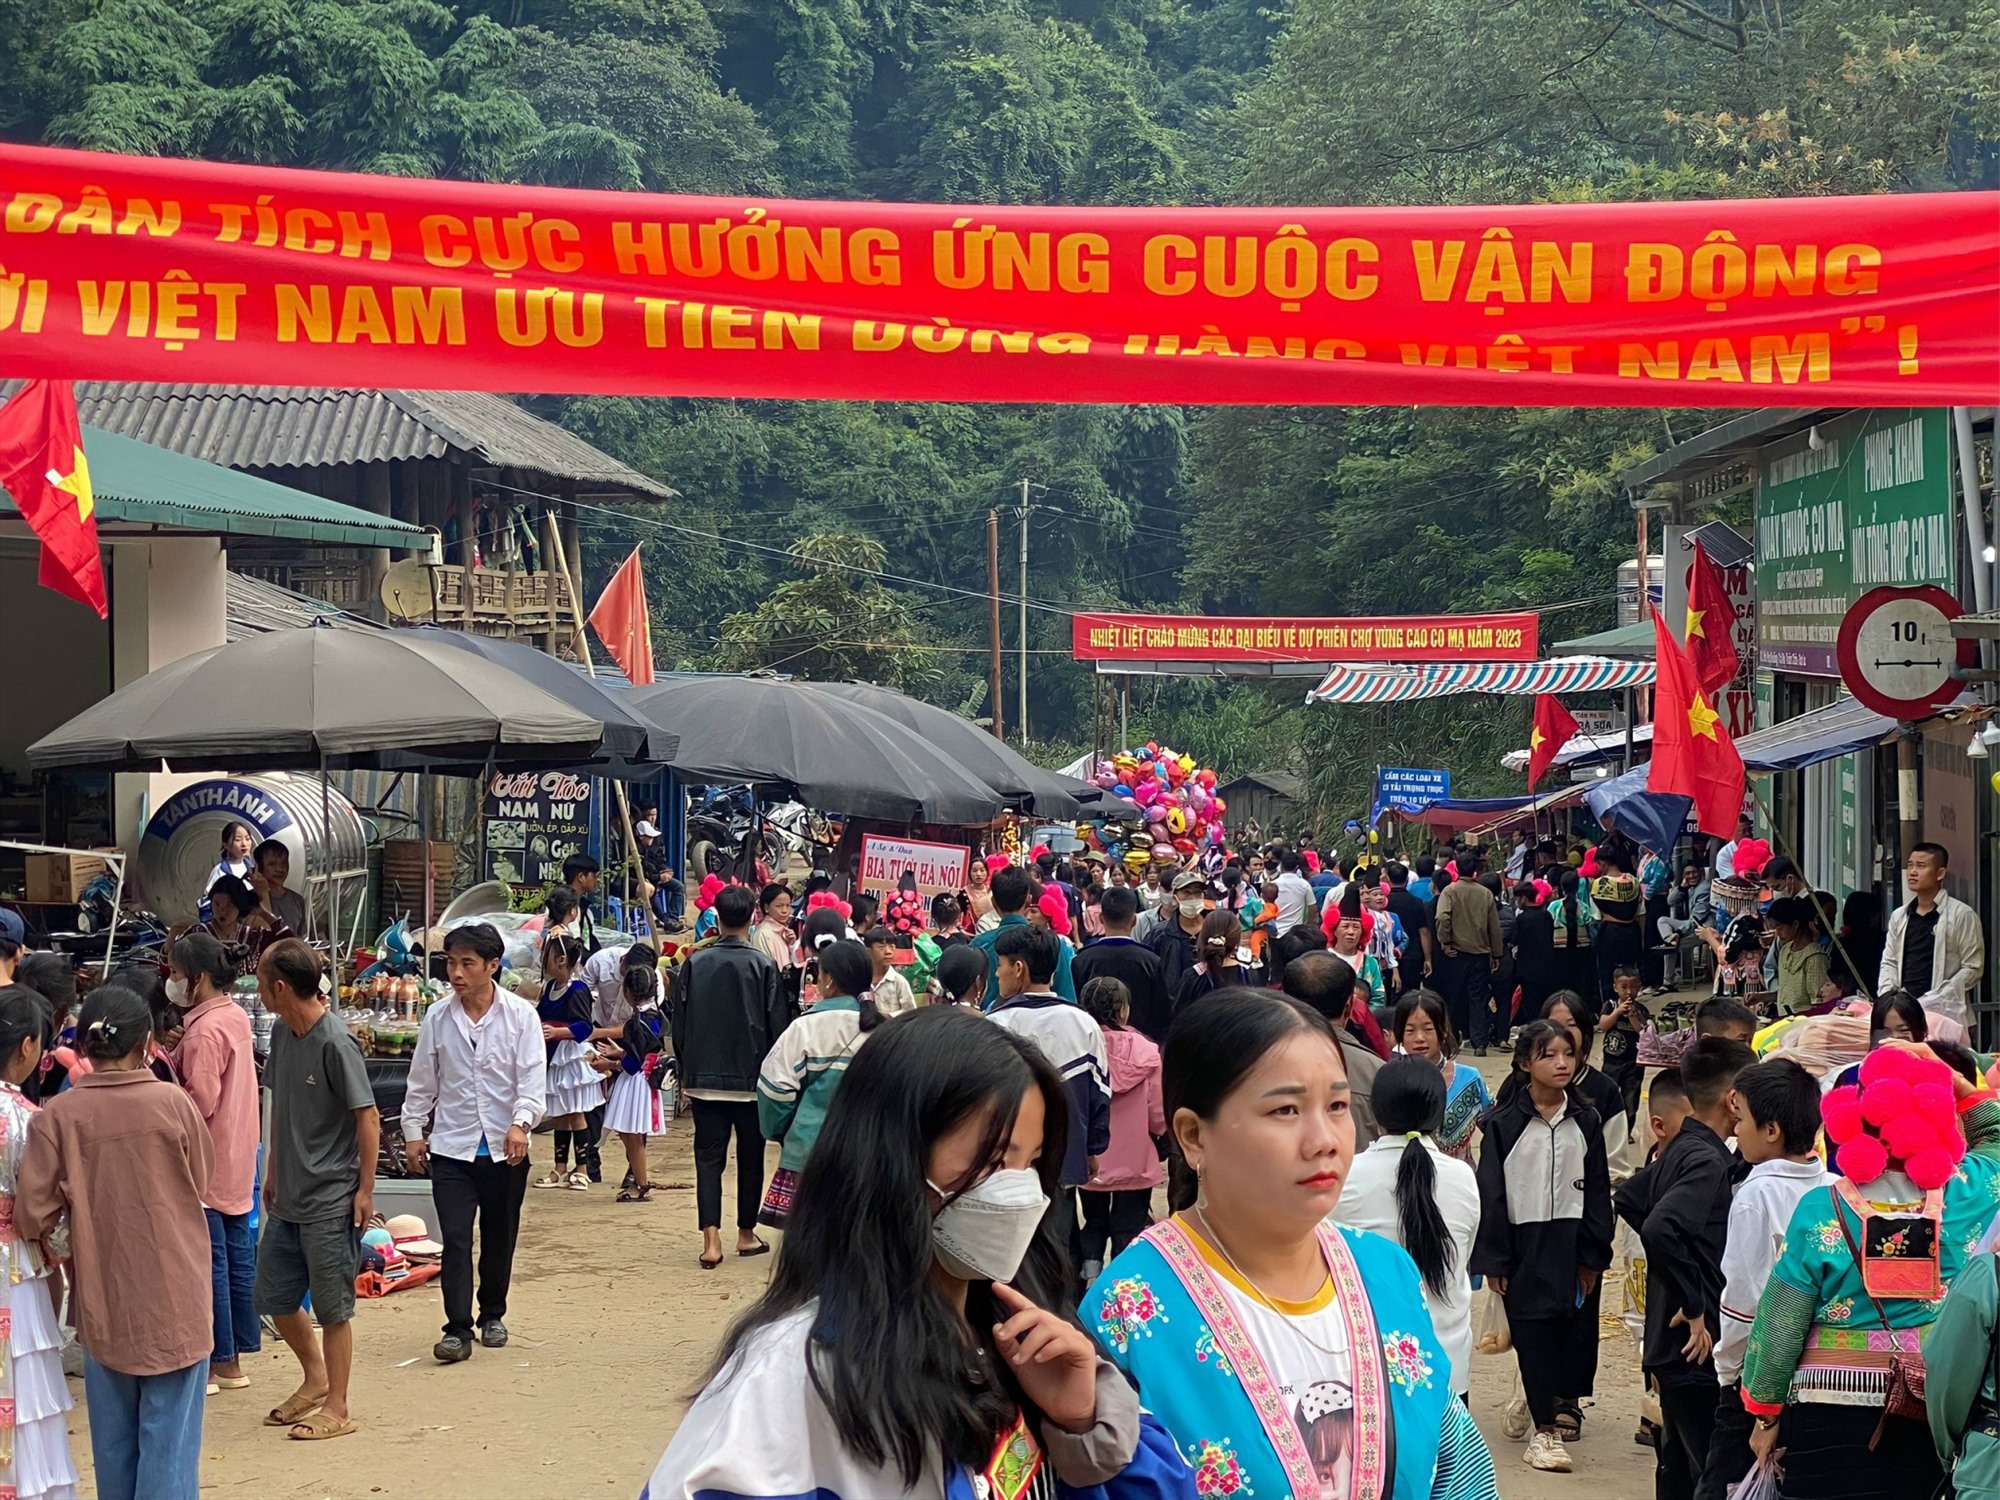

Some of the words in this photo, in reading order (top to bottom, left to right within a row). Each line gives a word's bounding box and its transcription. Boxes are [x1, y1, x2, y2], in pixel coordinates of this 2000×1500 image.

[5, 185, 182, 237] DÂN
[209, 195, 392, 261] TÍCH
[420, 212, 583, 279] CỰC
[612, 207, 901, 286] HƯỞNG
[932, 218, 1110, 293] ỨNG
[1143, 223, 1380, 312] CUỘC
[1411, 226, 1594, 316] VẬN
[1623, 230, 1882, 312] ĐỘNG
[77, 269, 247, 351] VIỆT
[274, 283, 467, 345] NAM
[495, 286, 605, 348] ƯU
[1090, 624, 1120, 651] NHIỆT
[1123, 624, 1144, 651] LIỆT
[1146, 624, 1175, 648] CHÀO
[1212, 624, 1233, 648] CÁC
[1236, 628, 1253, 652] ĐẠI
[1257, 621, 1280, 648] BIỂU
[1299, 627, 1314, 651] DỰ
[1316, 624, 1348, 648] PHIÊN
[1351, 627, 1373, 652] CHỢ
[1374, 624, 1403, 648] VÙNG
[1406, 628, 1428, 648] CAO
[1430, 628, 1445, 648] CO
[1447, 628, 1465, 652] MẠ
[1467, 624, 1493, 648] NĂM
[1495, 628, 1522, 648] 2023
[499, 801, 539, 819] NAM
[865, 856, 885, 880] BIA
[919, 857, 936, 886] HÀ
